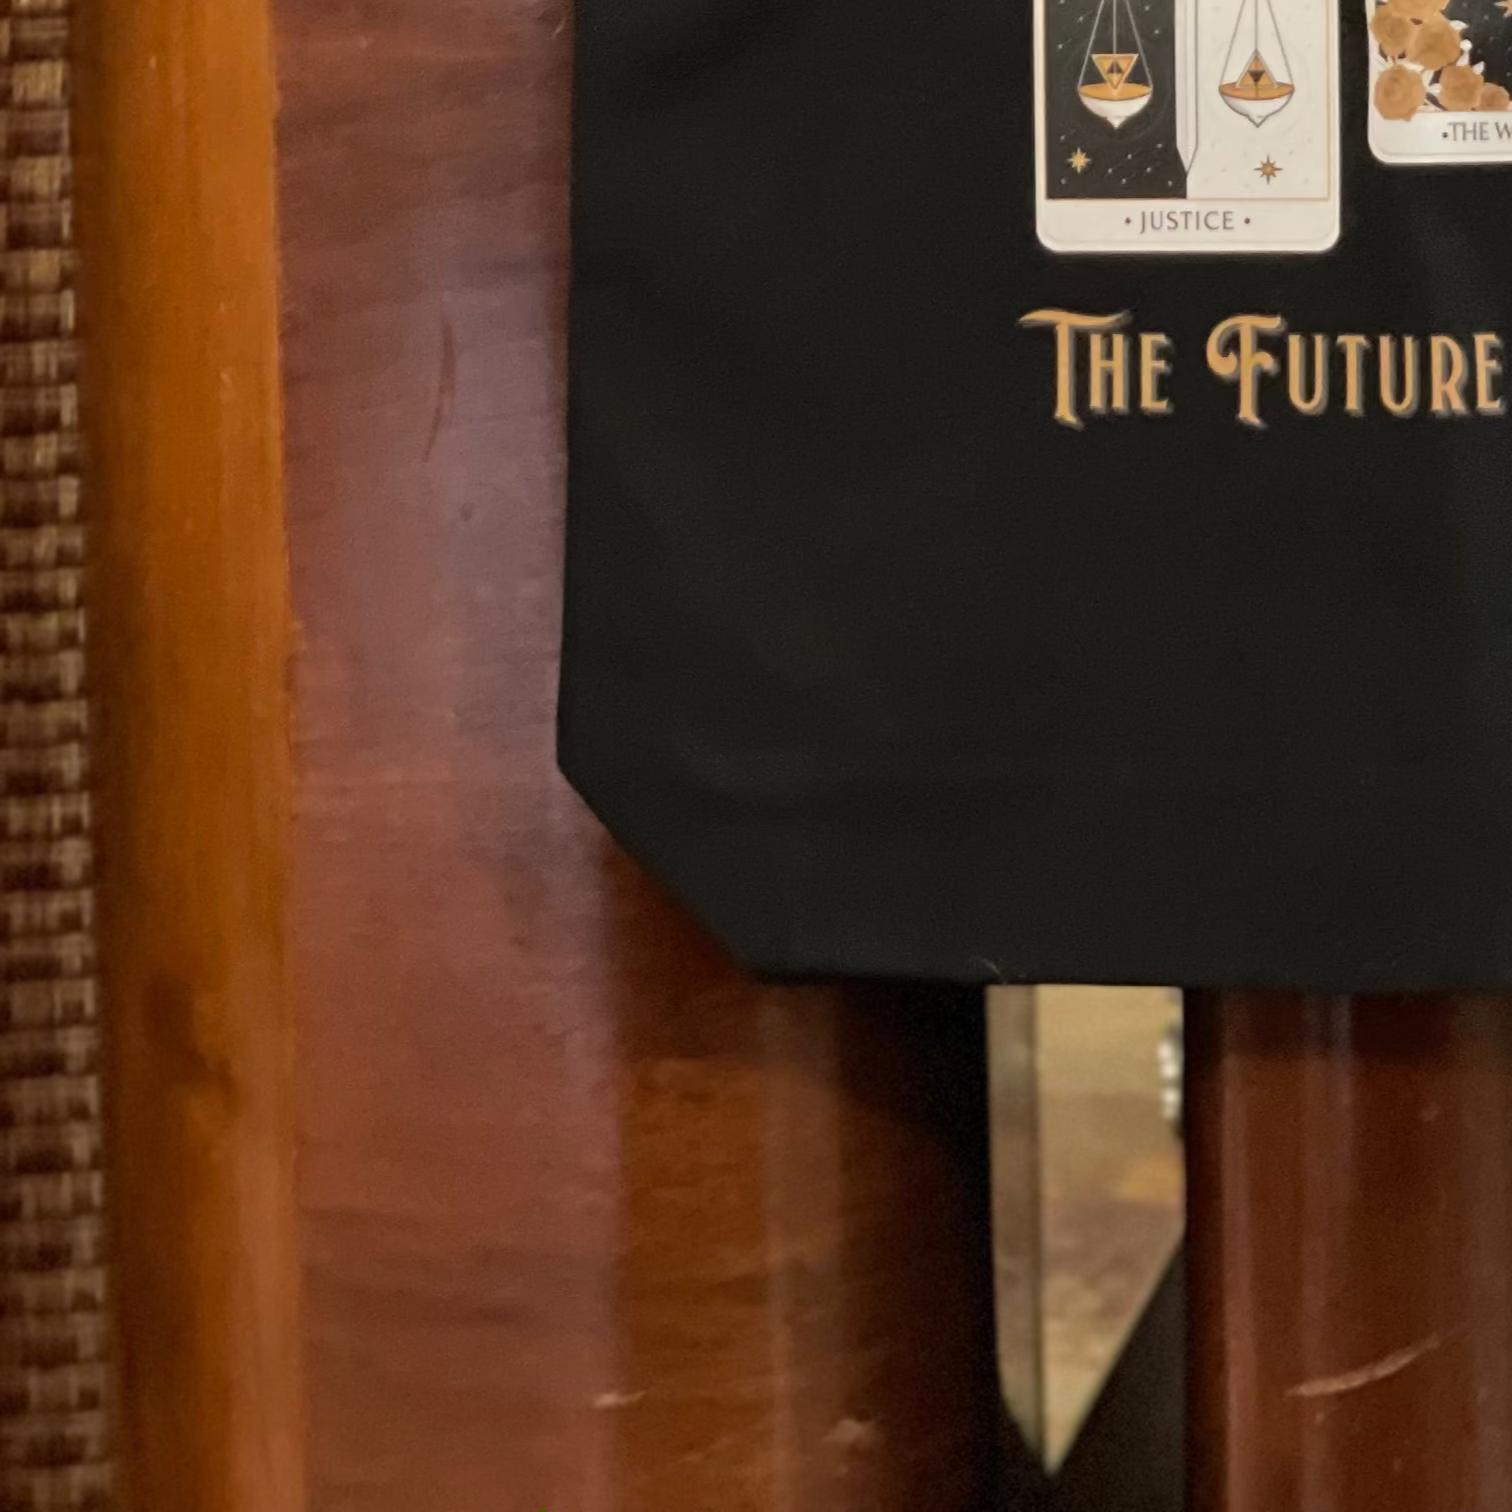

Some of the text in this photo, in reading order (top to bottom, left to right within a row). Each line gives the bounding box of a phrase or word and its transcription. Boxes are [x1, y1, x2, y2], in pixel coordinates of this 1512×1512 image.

[1447, 120, 1490, 141] THE
[1139, 210, 1235, 235] JUSTICE
[1018, 308, 1171, 428] THE
[1205, 314, 1505, 428] FUTURE
